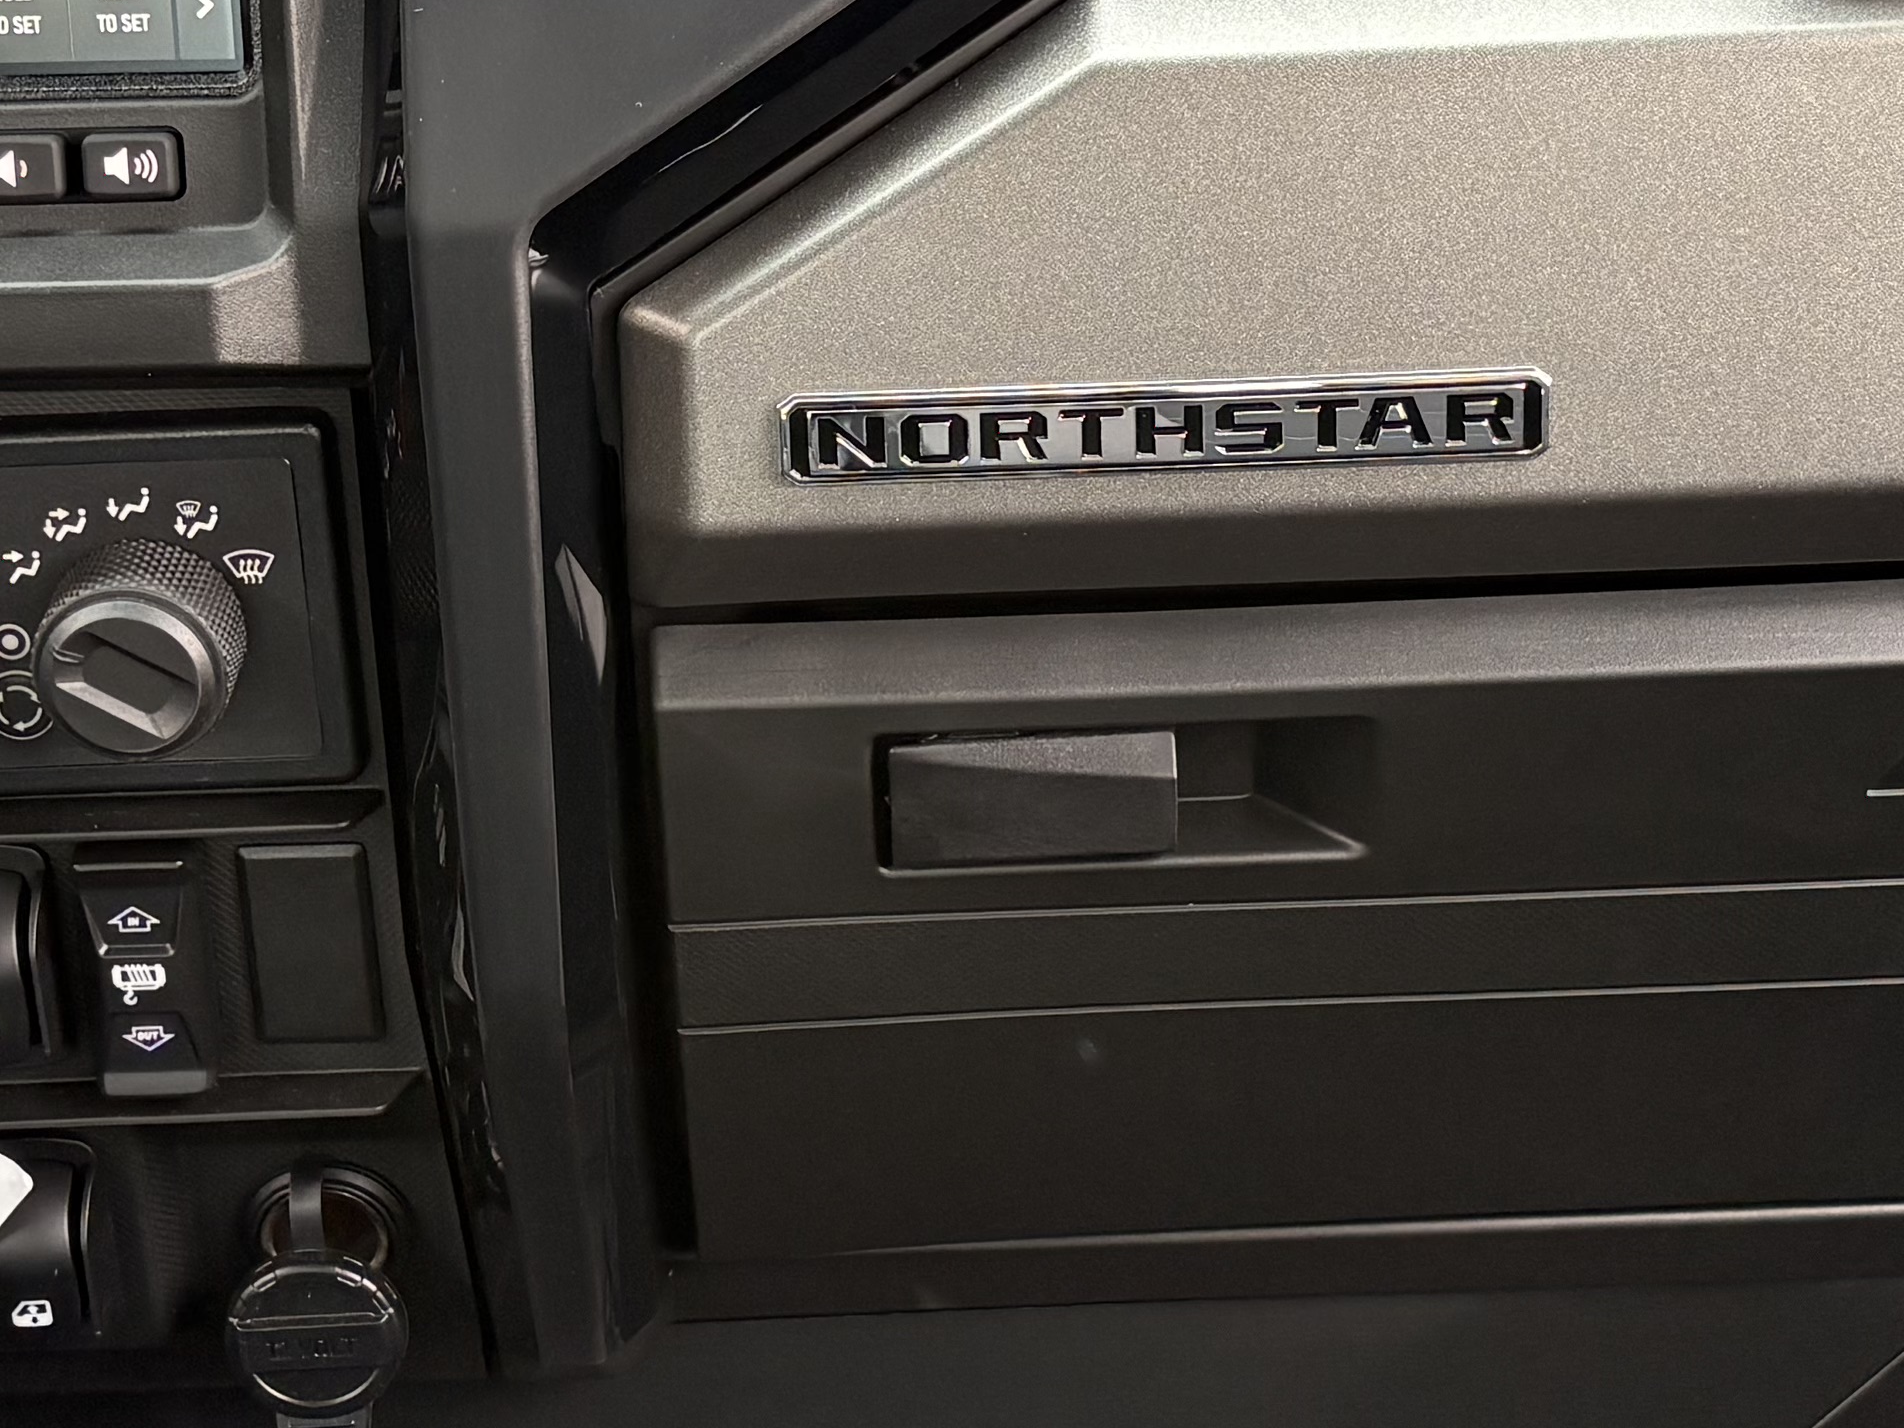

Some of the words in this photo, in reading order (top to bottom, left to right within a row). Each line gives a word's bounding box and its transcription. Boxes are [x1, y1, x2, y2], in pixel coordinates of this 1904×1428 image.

[13, 16, 41, 34] SET
[96, 14, 117, 32] TO
[121, 14, 150, 32] SET
[816, 390, 1517, 472] NORTHSTAR
